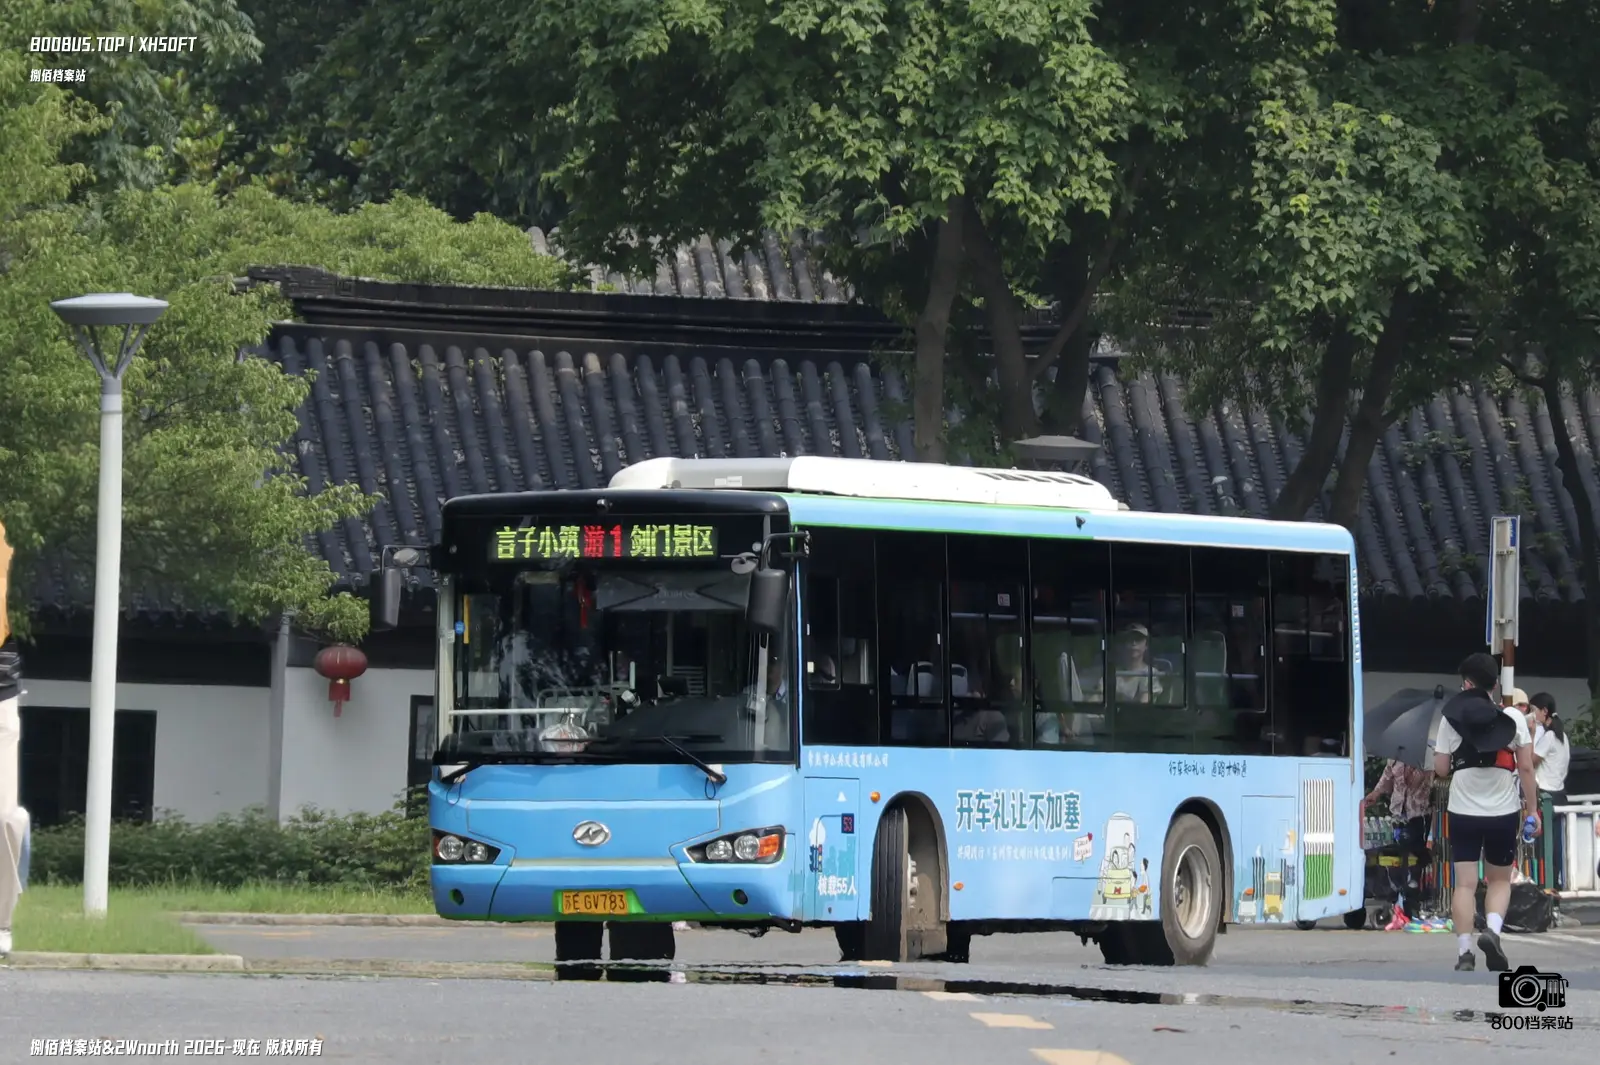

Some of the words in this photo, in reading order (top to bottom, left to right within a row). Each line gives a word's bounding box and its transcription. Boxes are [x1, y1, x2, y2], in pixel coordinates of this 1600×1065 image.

[630, 524, 714, 557] 剑门景区
[956, 789, 1081, 831] 开车礼让不加塞
